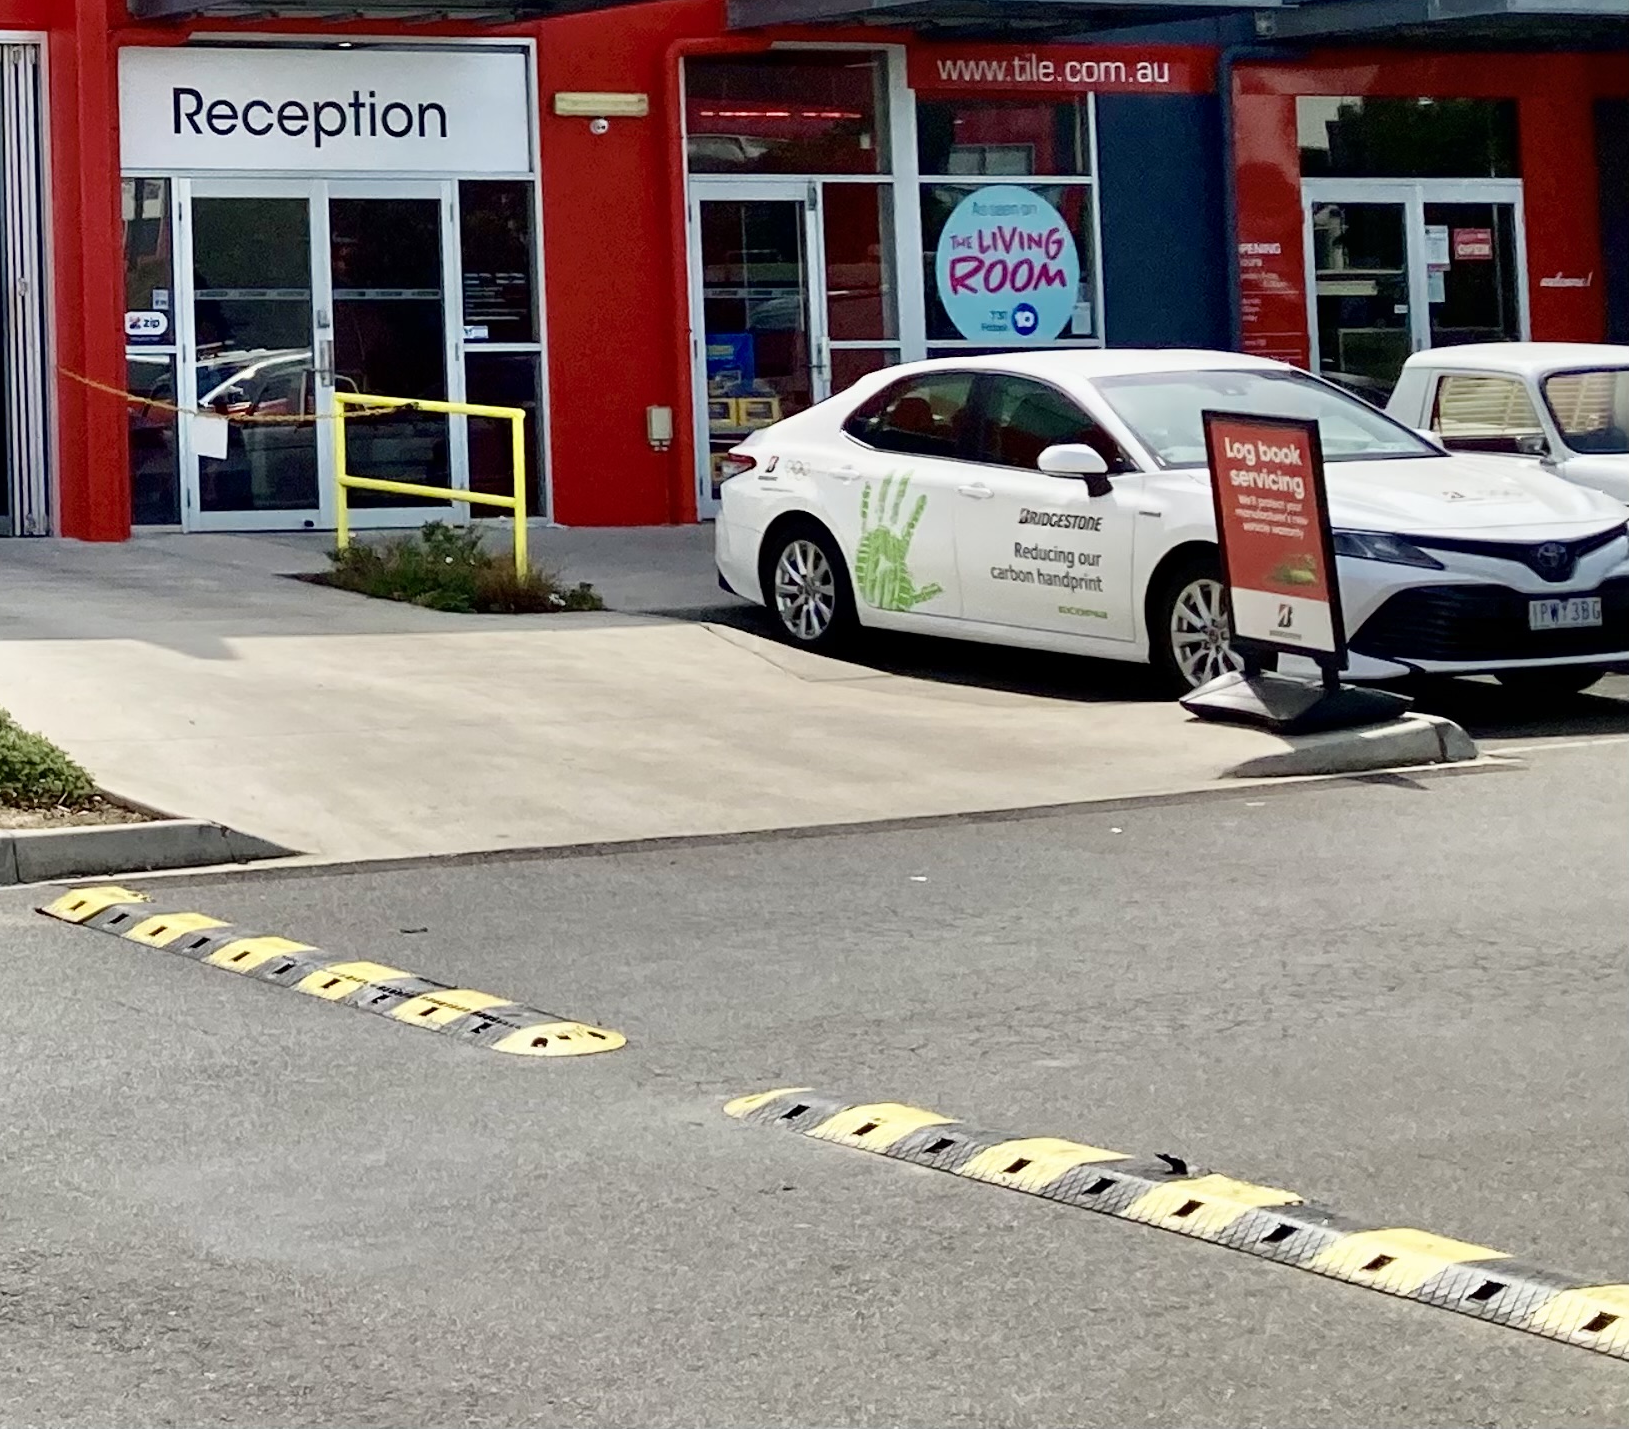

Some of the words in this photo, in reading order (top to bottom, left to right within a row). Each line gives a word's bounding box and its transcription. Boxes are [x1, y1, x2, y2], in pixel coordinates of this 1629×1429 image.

[937, 53, 1170, 83] www.tile.com.au
[172, 87, 448, 148] Reception
[949, 234, 973, 250] THE
[977, 225, 1065, 261] LIVING
[949, 255, 1068, 295] ROOM
[143, 317, 160, 328] zip
[1224, 437, 1256, 466] Log
[1258, 440, 1302, 466] book
[1229, 469, 1305, 499] servicing
[1018, 508, 1104, 532] BRIDGESTONE
[1014, 542, 1075, 569] Reducing
[1078, 552, 1102, 567] our
[991, 564, 1035, 584] carbon
[1037, 568, 1104, 593] handprint
